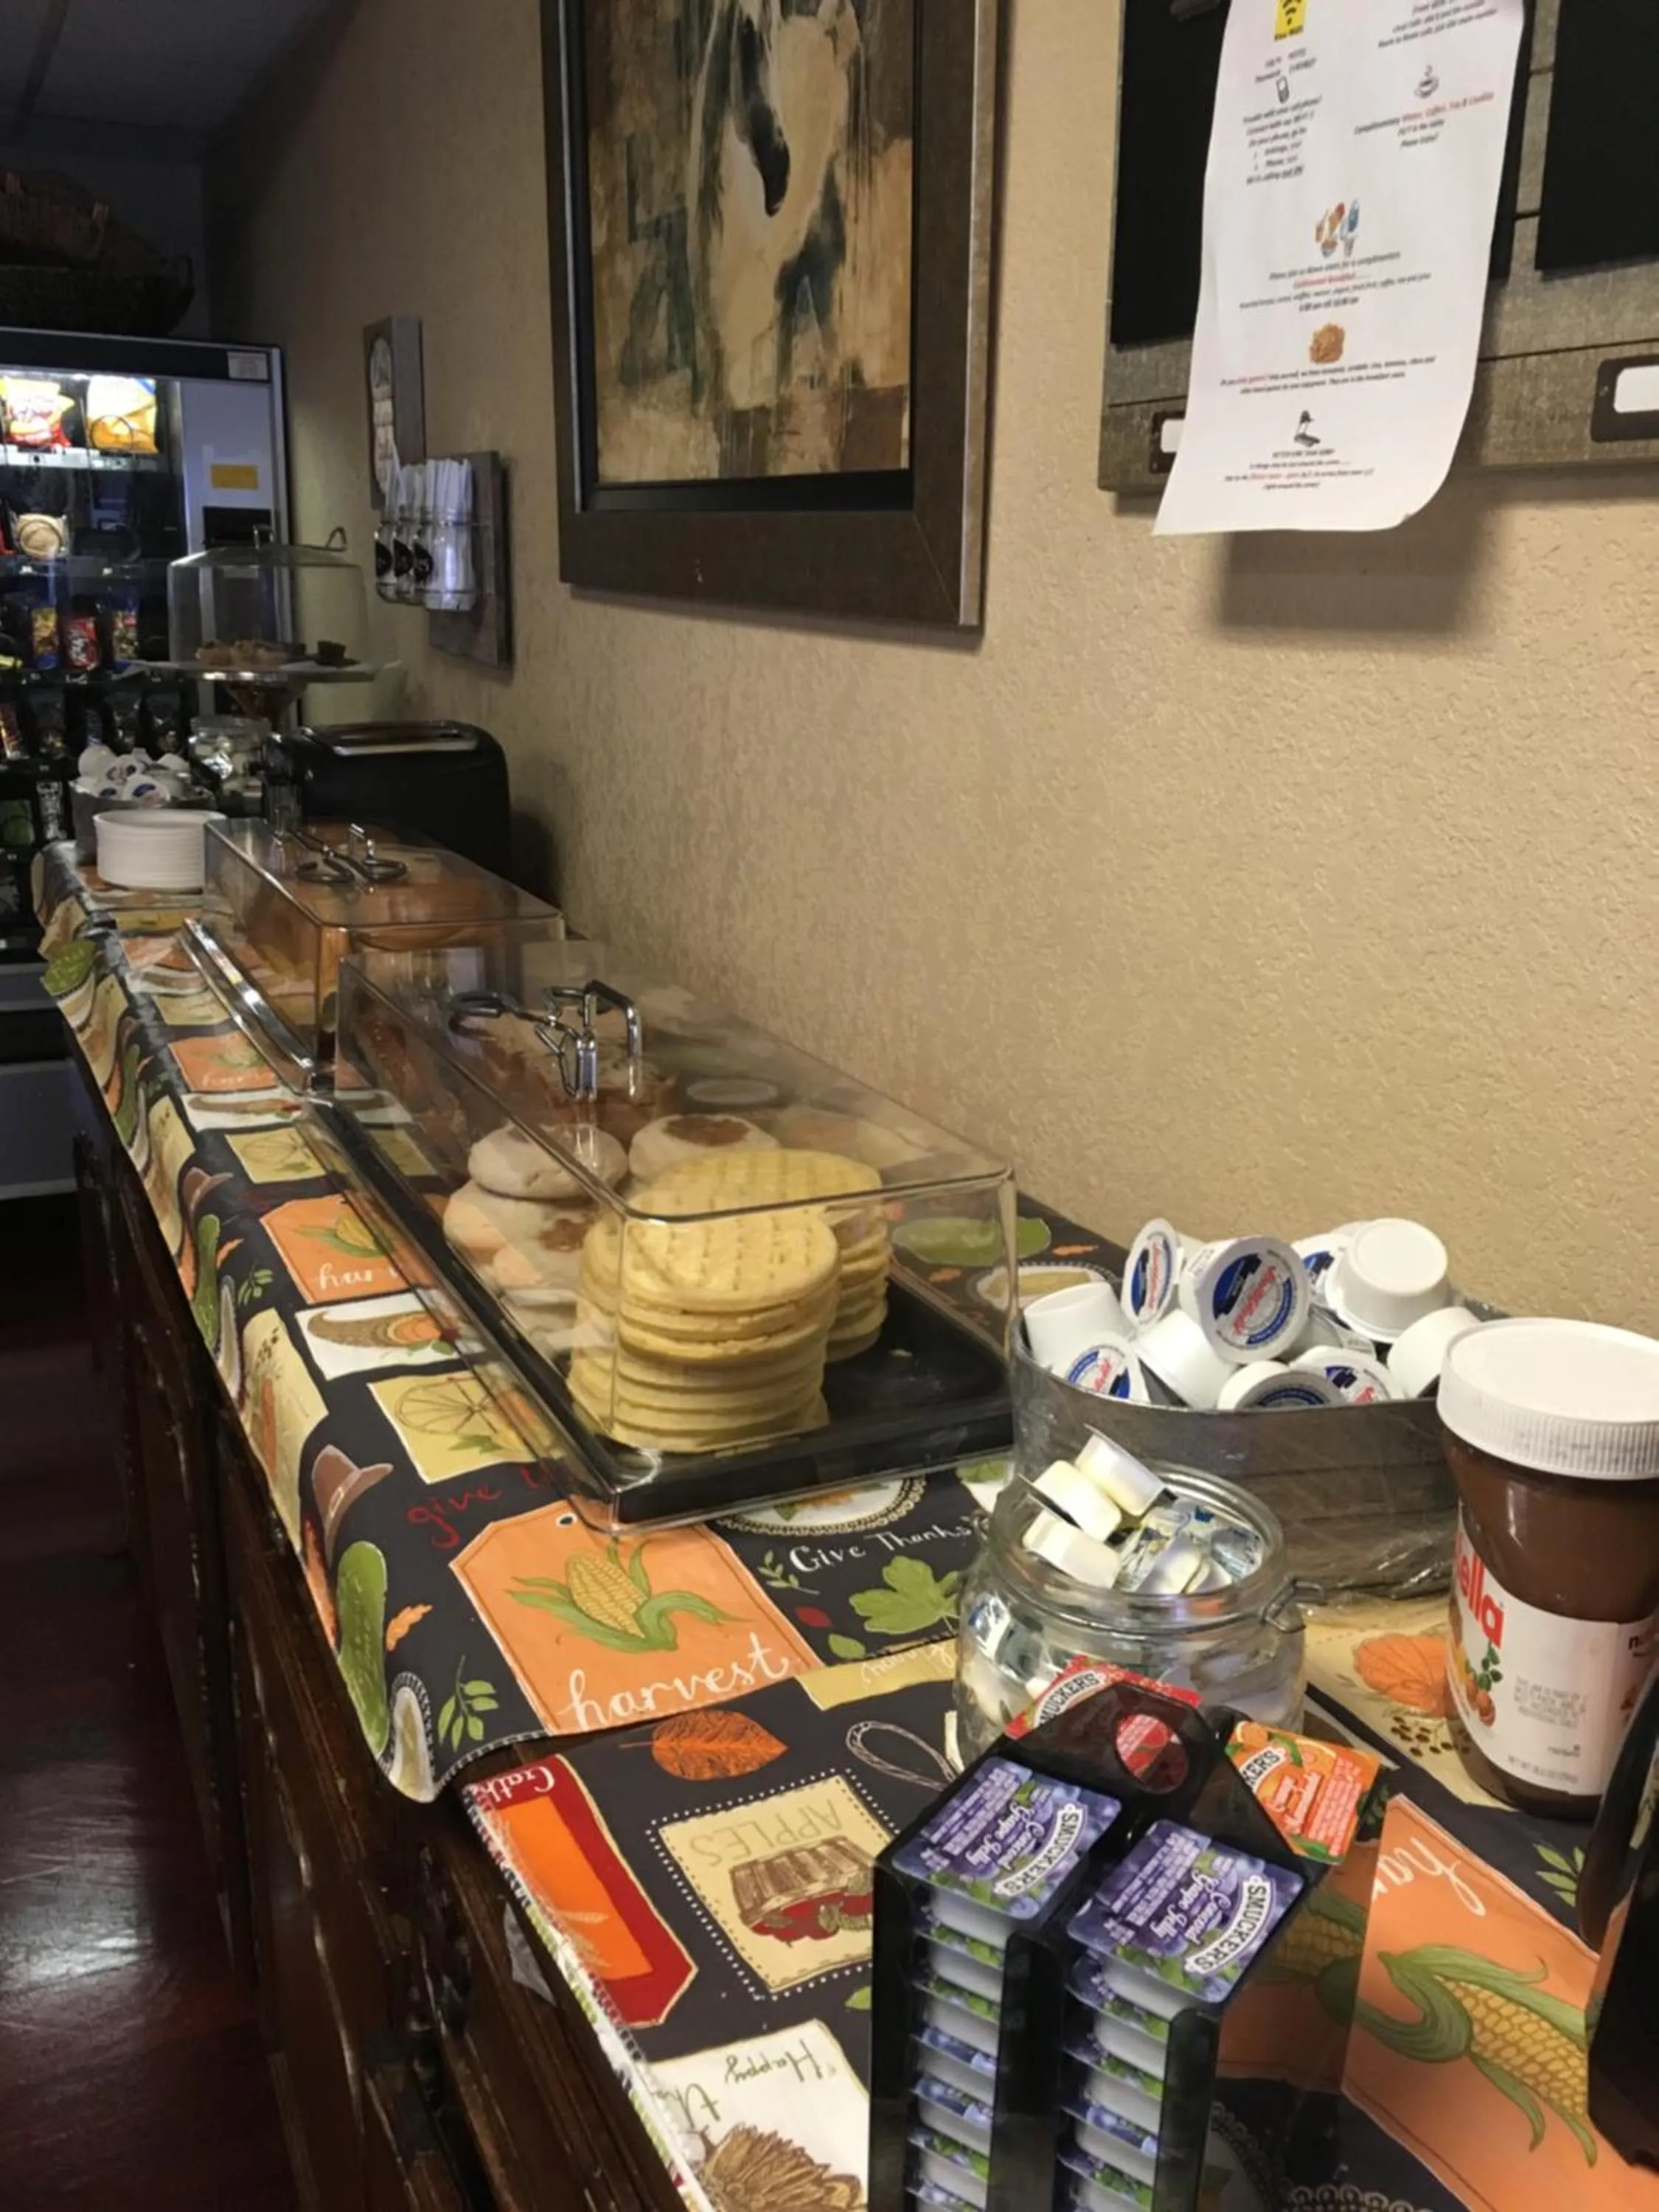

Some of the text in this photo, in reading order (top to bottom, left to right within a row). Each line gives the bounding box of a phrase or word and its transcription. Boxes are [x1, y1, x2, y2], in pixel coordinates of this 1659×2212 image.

[789, 1545, 866, 1573] Give
[556, 1632, 790, 1731] harvest
[689, 1799, 843, 1867] APPLES
[725, 2039, 823, 2087] Happy
